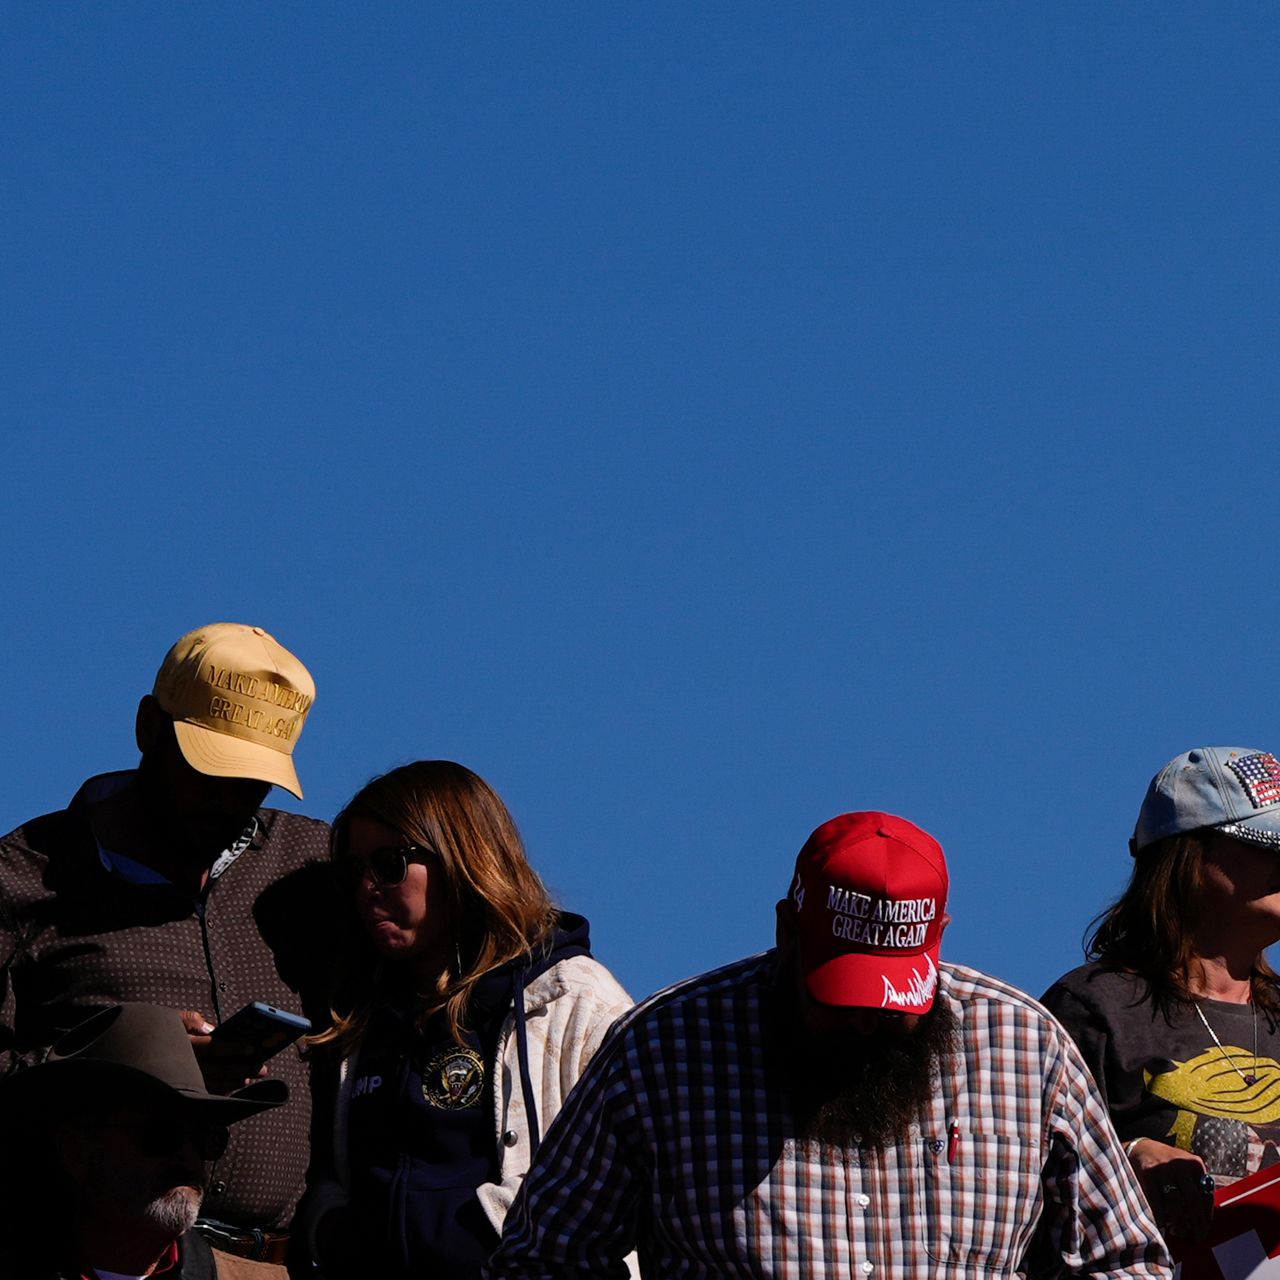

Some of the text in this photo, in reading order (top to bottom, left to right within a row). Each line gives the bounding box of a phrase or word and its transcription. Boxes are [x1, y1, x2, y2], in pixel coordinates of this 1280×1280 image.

[207, 665, 259, 699] MAKE
[209, 696, 298, 741] GREAT AGAI
[827, 885, 936, 923] MAKE AMERICA
[832, 914, 929, 948] GREAT AGAIN
